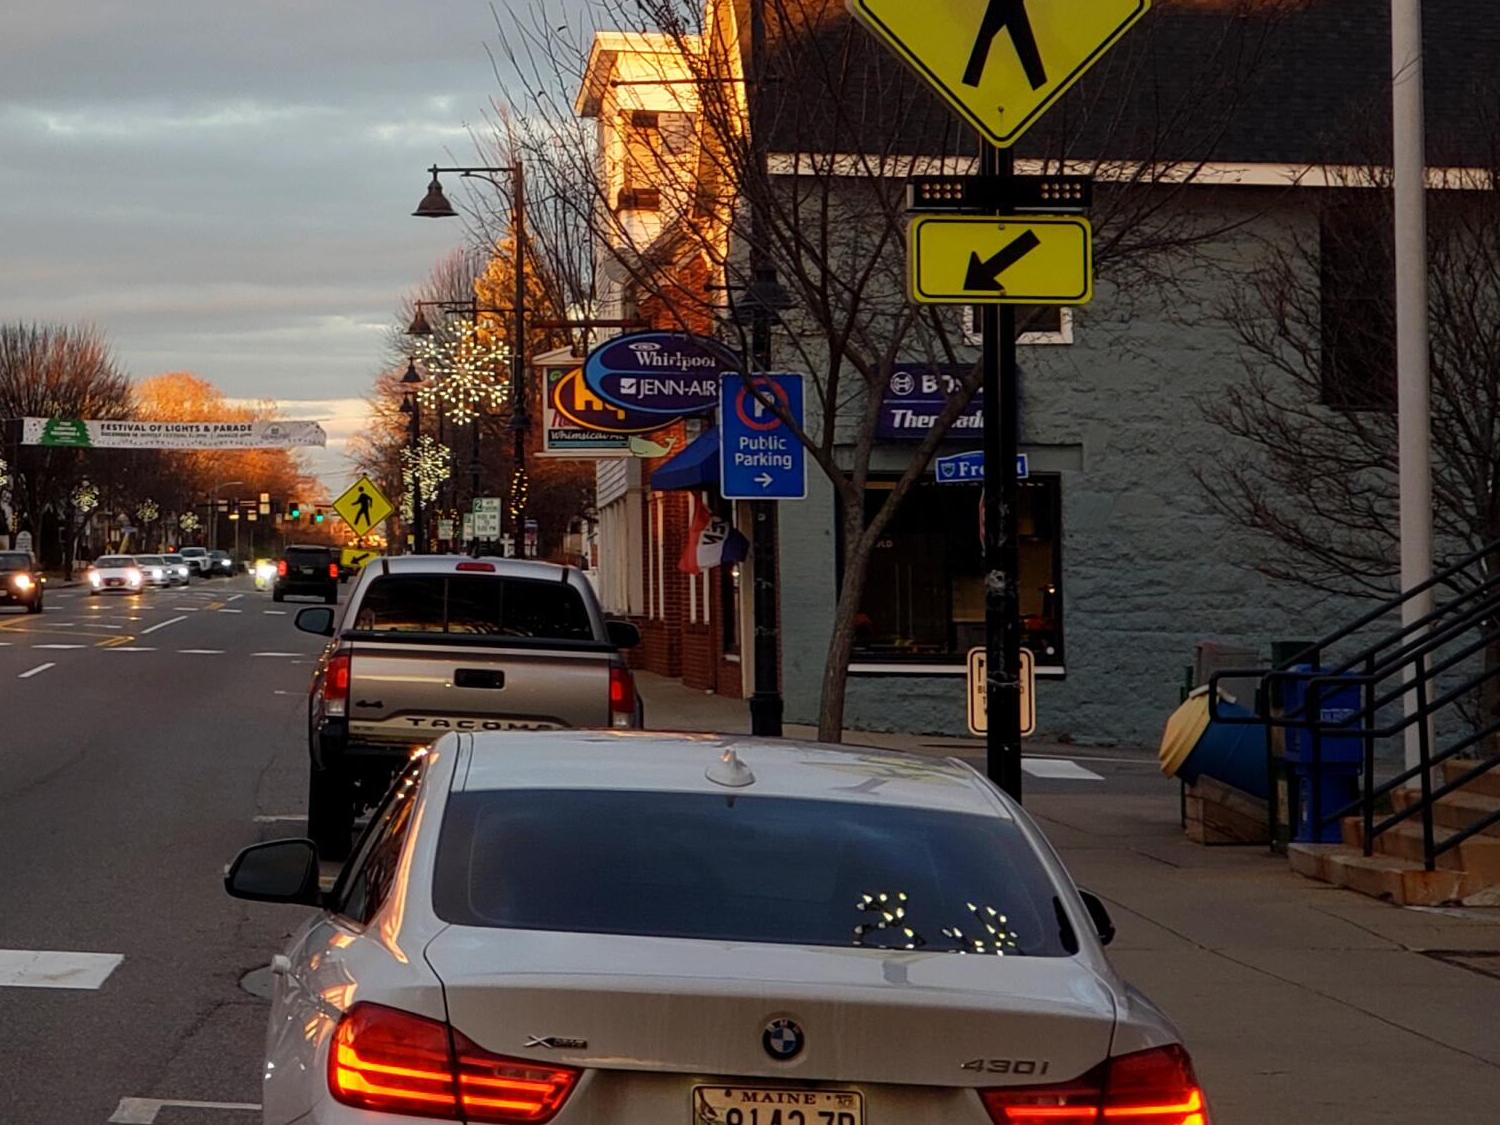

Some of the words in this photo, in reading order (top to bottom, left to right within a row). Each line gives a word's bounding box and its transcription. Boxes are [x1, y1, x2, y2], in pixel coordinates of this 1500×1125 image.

[634, 351, 716, 371] Whirlpool
[638, 379, 717, 399] JENN-AIR
[101, 423, 146, 432] FESTIVAL
[149, 424, 162, 432] OF
[165, 424, 200, 432] LIGHTS
[213, 424, 252, 432] PARADE
[739, 436, 787, 451] Public
[734, 453, 792, 470] Parking
[958, 461, 1023, 477] Frt
[742, 1091, 816, 1105] MAINE
